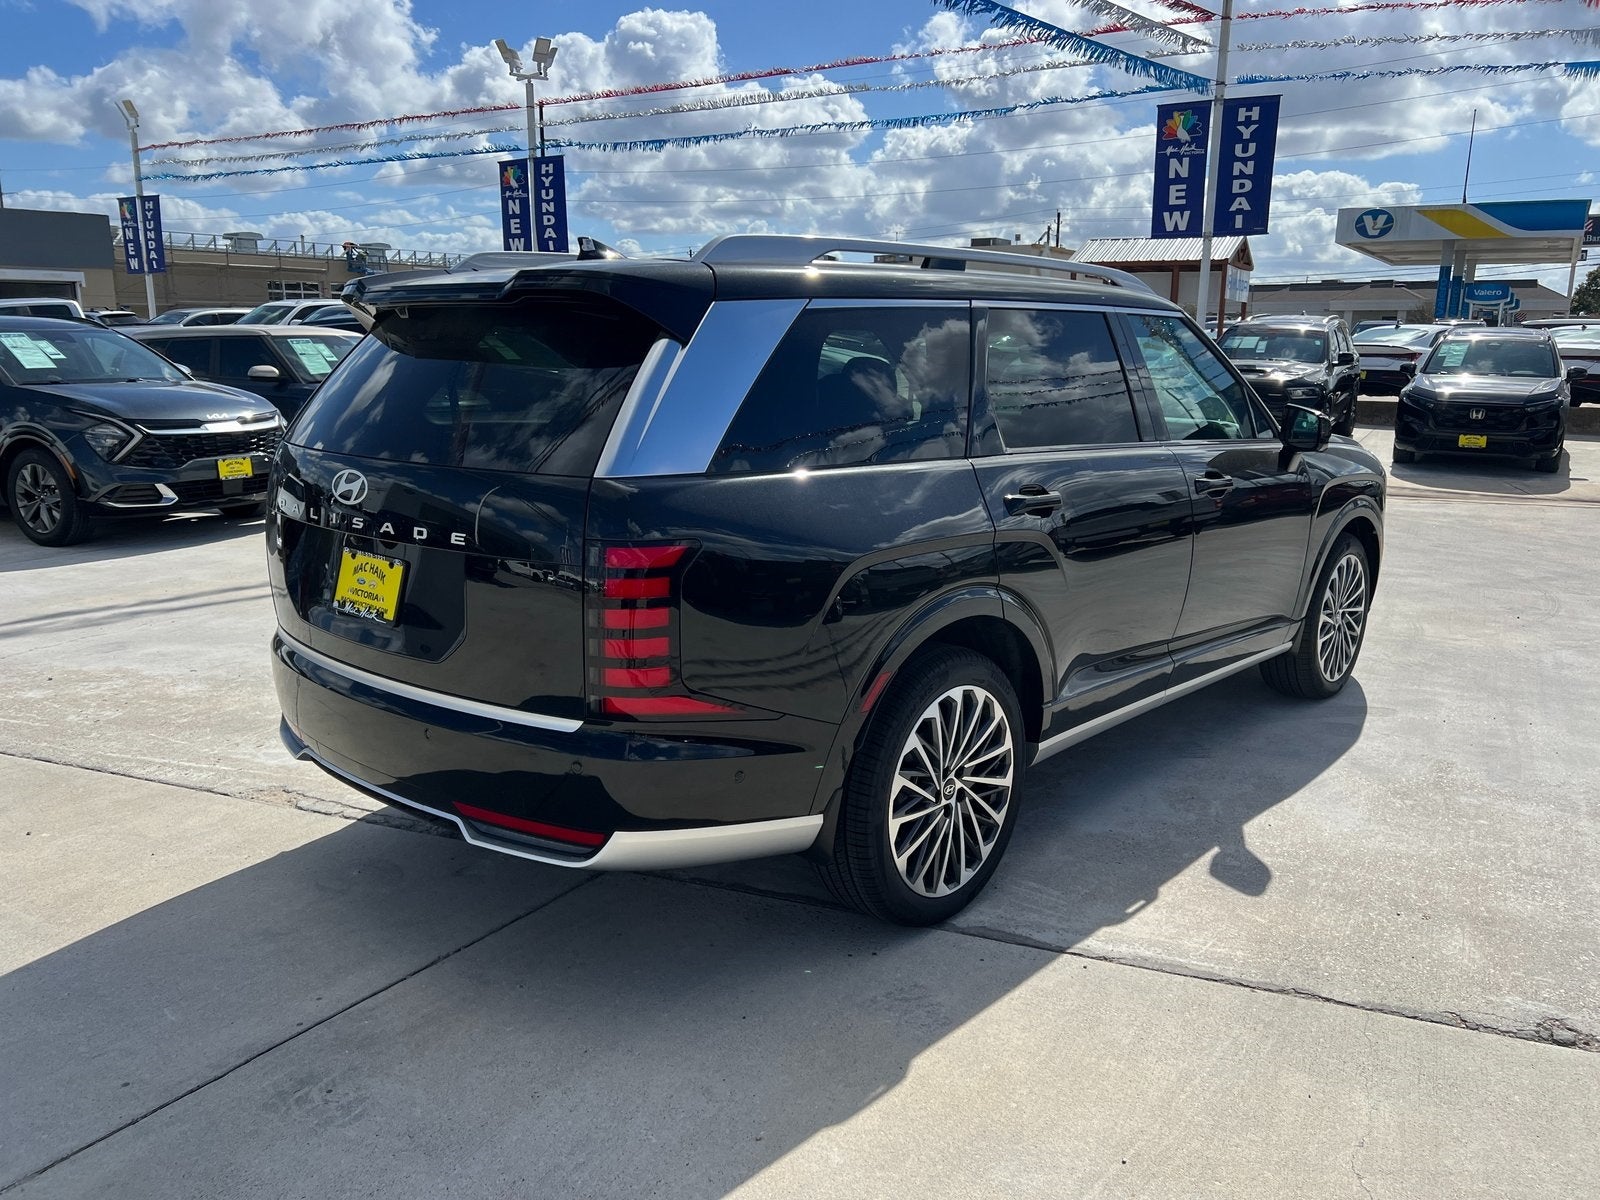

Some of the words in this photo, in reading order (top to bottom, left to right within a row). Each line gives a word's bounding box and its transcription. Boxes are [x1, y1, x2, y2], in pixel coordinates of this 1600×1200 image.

[1229, 106, 1260, 229] HYUNDAI
[541, 163, 557, 251] HYUNDAI
[1162, 157, 1191, 232] NEW
[125, 228, 139, 270] NEW
[145, 201, 157, 269] HYUNDAI
[508, 199, 525, 252] NEW
[1474, 287, 1502, 296] Valero
[279, 497, 467, 546] PALISADE
[352, 562, 369, 576] MAC
[369, 562, 386, 585] HAIK
